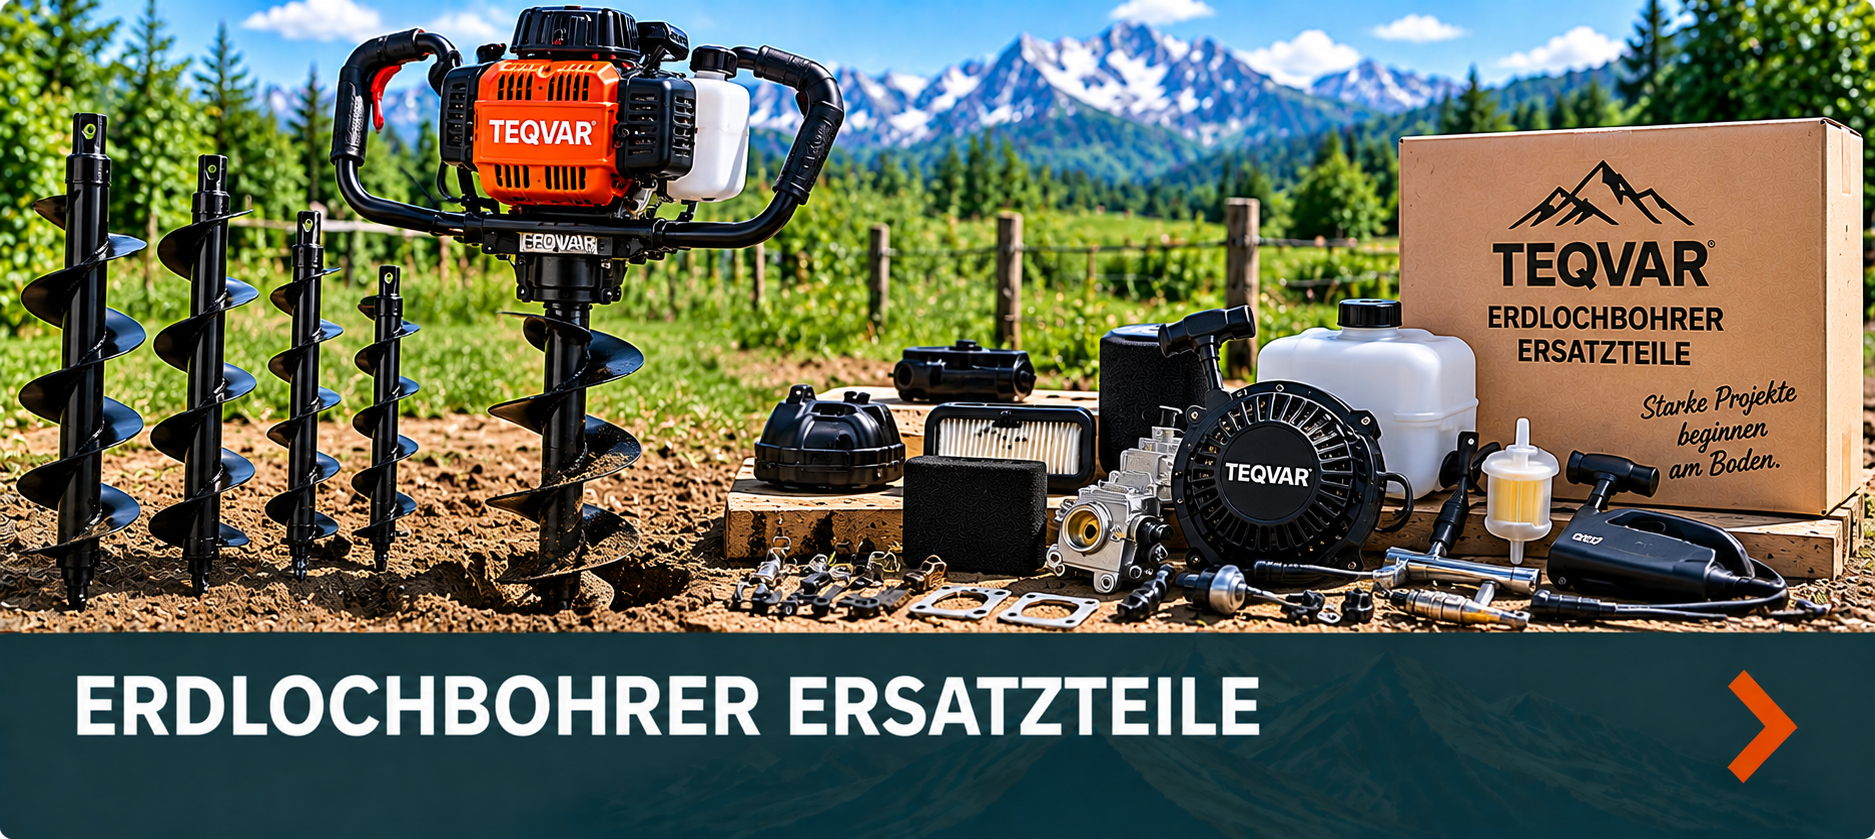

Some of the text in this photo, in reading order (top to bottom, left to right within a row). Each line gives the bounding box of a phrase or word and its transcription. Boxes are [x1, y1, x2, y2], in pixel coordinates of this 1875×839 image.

[1488, 305, 1724, 332] ERDLOCHBOHRER
[1518, 338, 1691, 366] ERSATZTEILE
[1640, 379, 1798, 420] Starke Projekte
[1677, 421, 1769, 454] beginnen
[1225, 462, 1309, 487] TEQVAR
[1668, 447, 1782, 480] am Boden.
